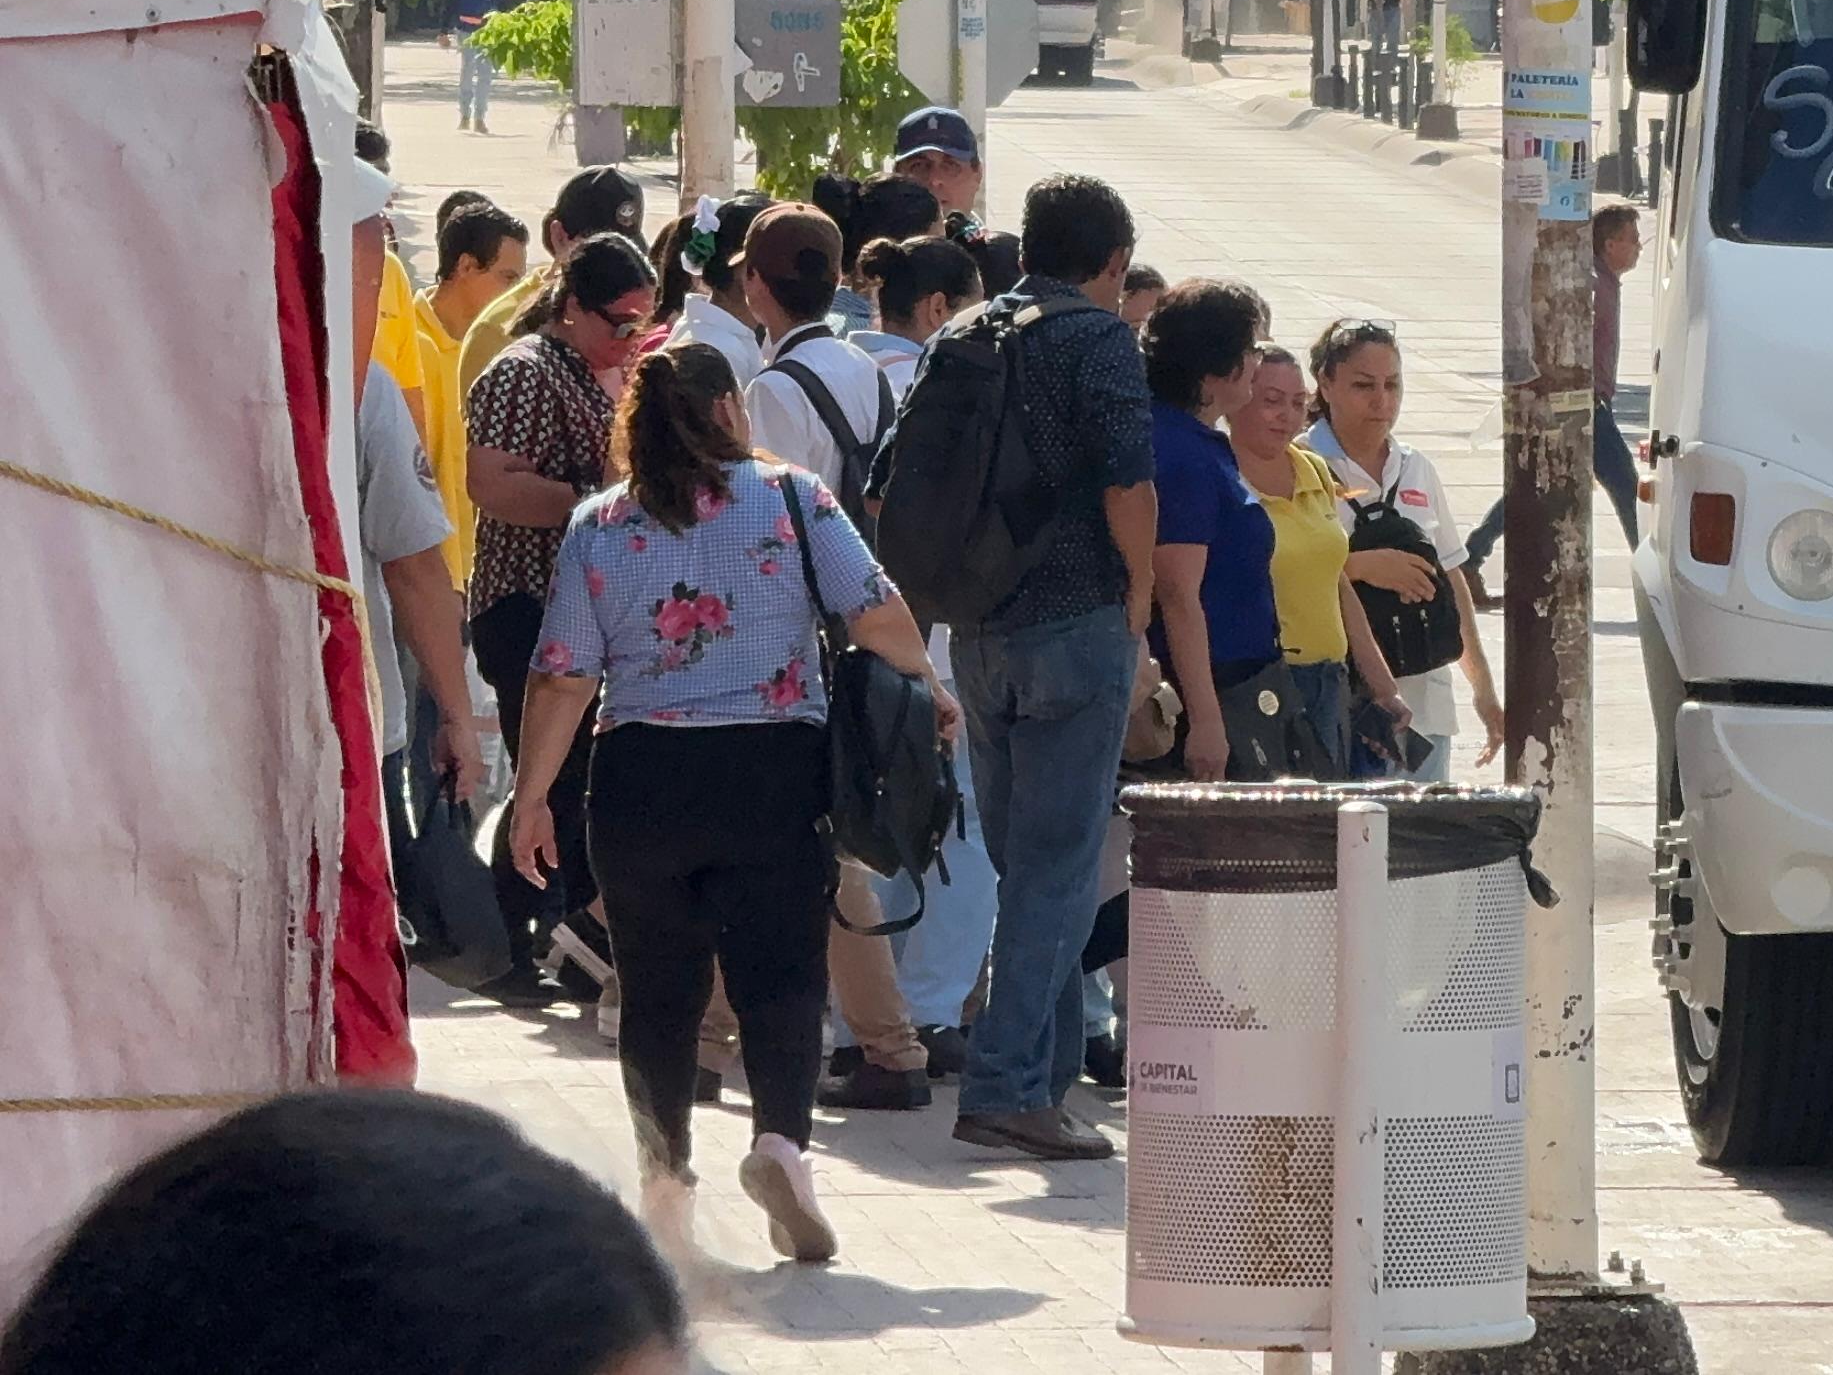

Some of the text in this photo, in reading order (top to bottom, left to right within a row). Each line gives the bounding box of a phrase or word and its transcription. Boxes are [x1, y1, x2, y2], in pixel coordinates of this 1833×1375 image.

[1511, 72, 1579, 87] PALETERÍA
[1511, 89, 1524, 99] LA
[1140, 1061, 1198, 1081] CAPITAL
